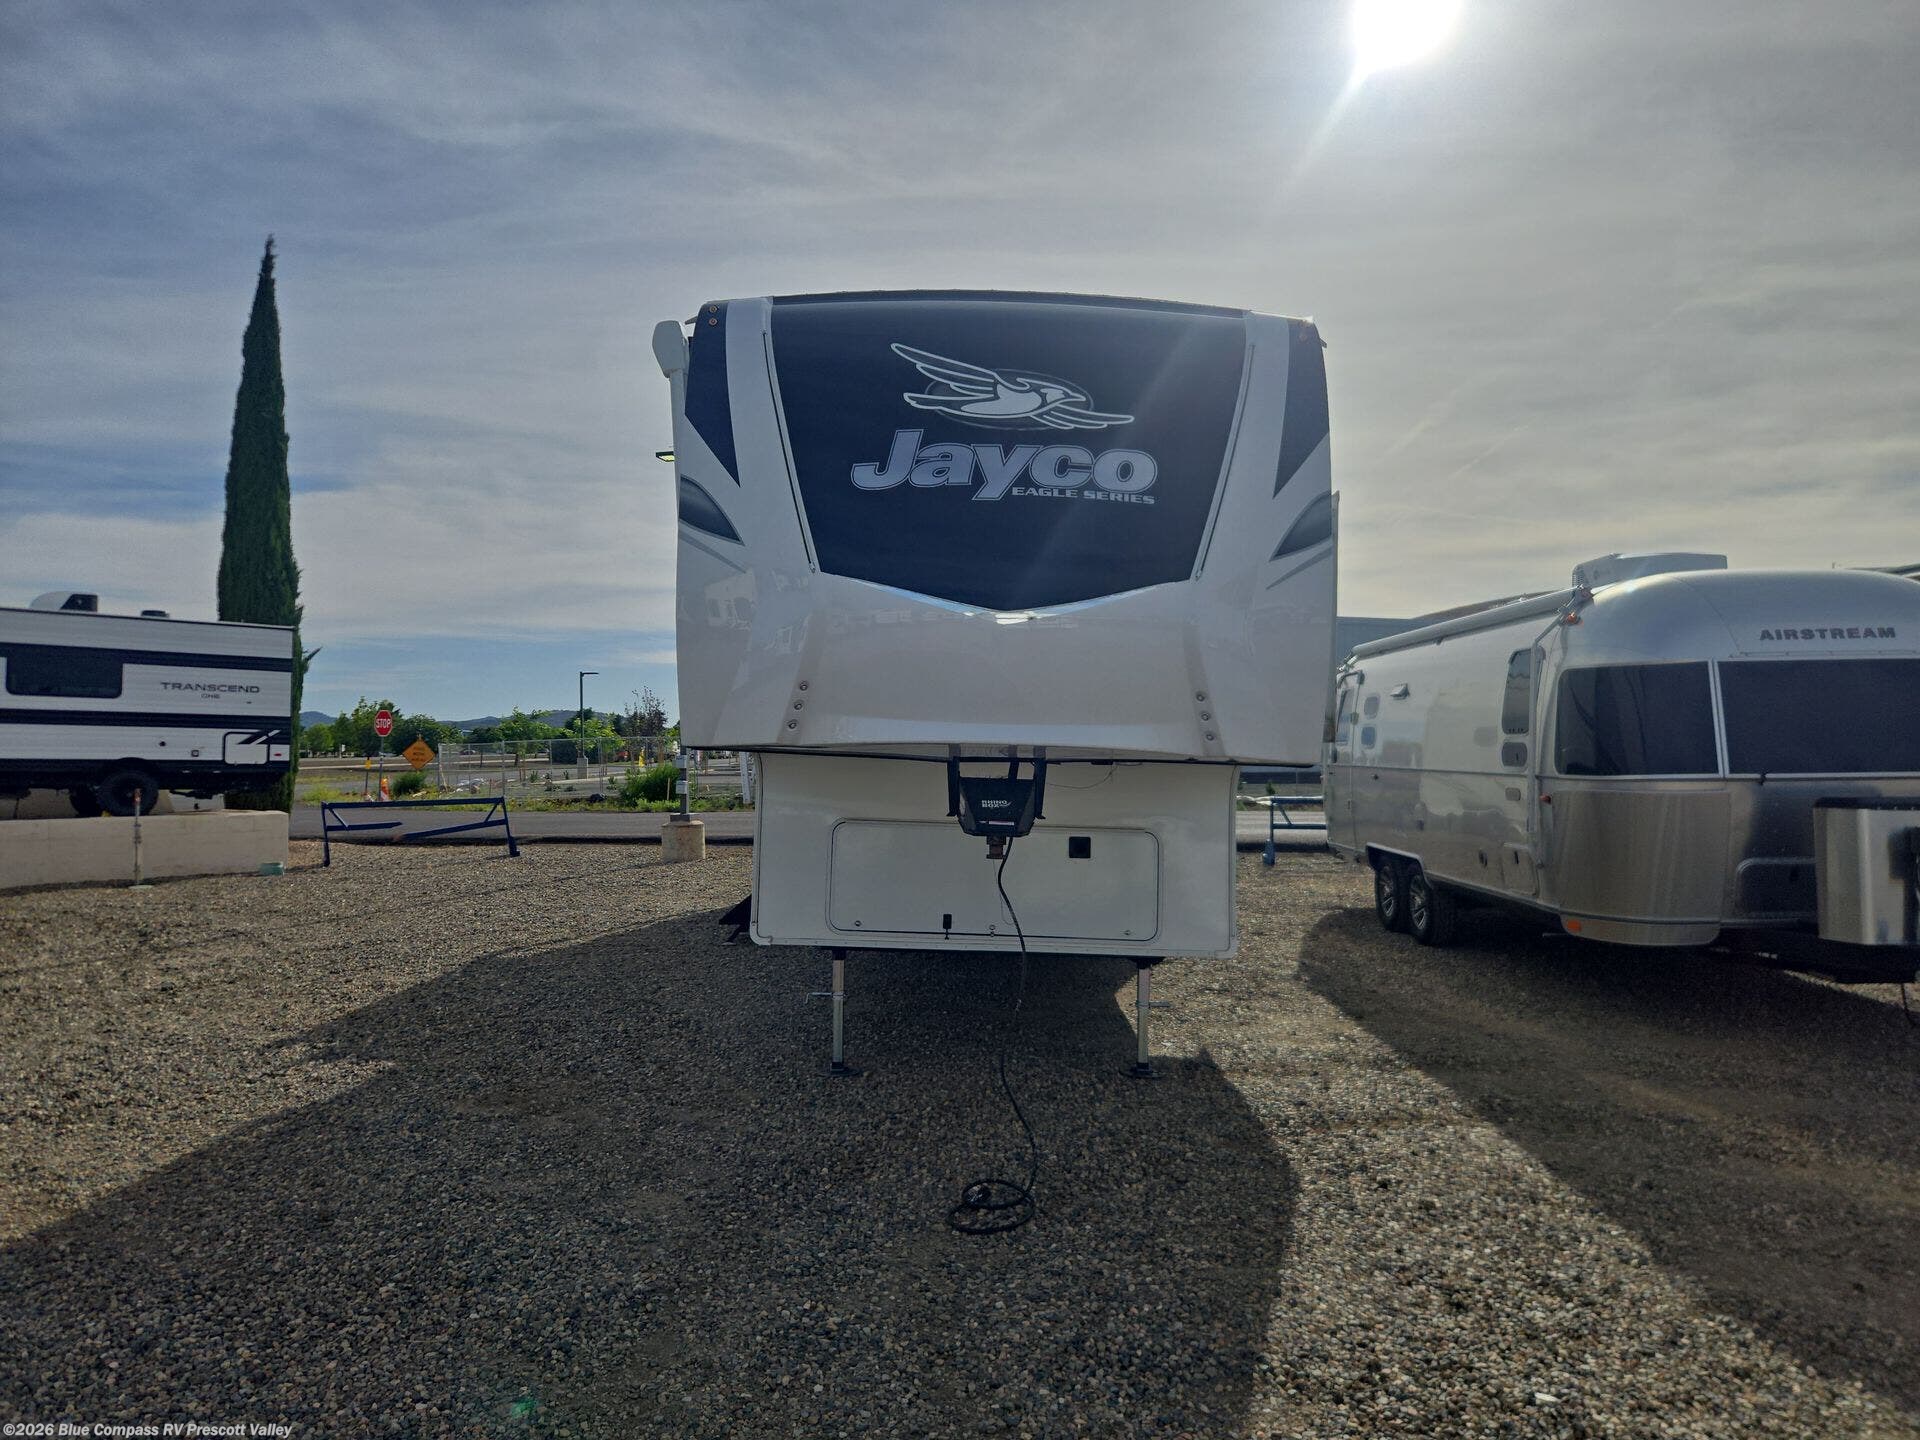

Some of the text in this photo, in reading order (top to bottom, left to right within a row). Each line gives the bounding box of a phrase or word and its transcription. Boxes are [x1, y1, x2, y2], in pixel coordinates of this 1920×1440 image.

[850, 428, 1158, 501] Jayco
[1012, 486, 1156, 505] EAGLE SERIES
[1759, 627, 1897, 641] AIRSTREAM
[160, 681, 261, 694] TRANSCEND
[376, 718, 392, 729] STOP
